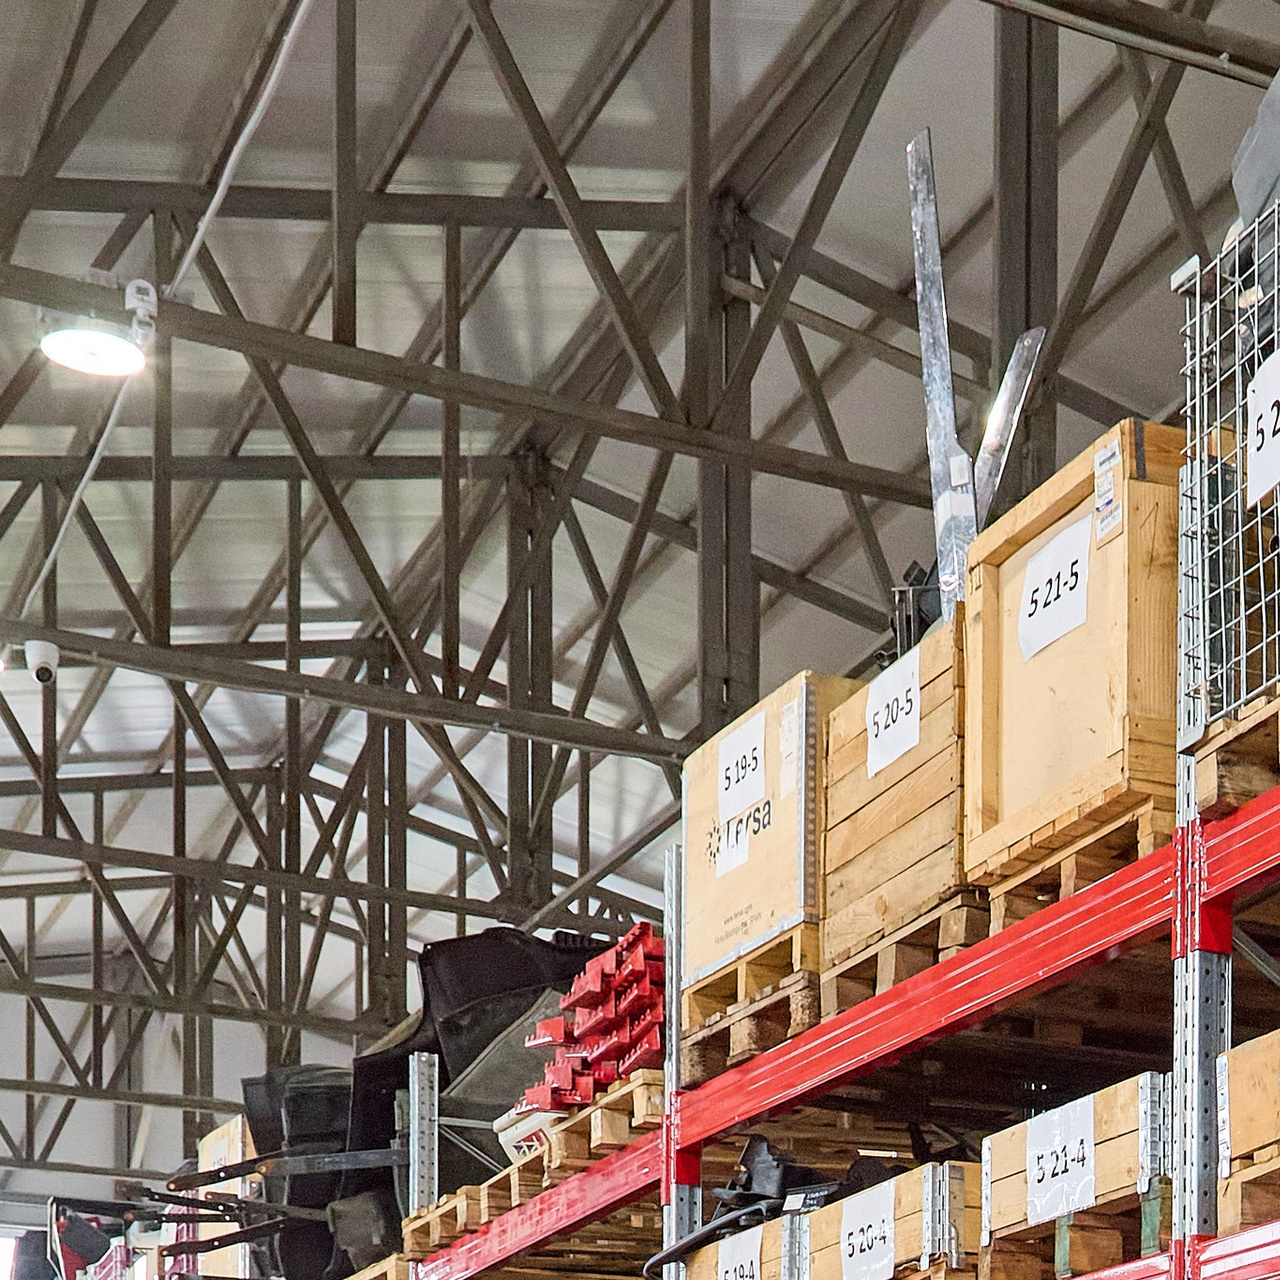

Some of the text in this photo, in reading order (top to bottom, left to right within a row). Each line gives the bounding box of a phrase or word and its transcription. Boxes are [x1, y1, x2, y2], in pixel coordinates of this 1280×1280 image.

[1256, 413, 1265, 453] 5
[1027, 558, 1079, 618] 5 21-5
[873, 687, 914, 739] 5 20-5
[724, 746, 759, 791] 5 19-5
[1036, 1138, 1087, 1184] 5 21-4
[847, 1218, 888, 1259] 5 20-4
